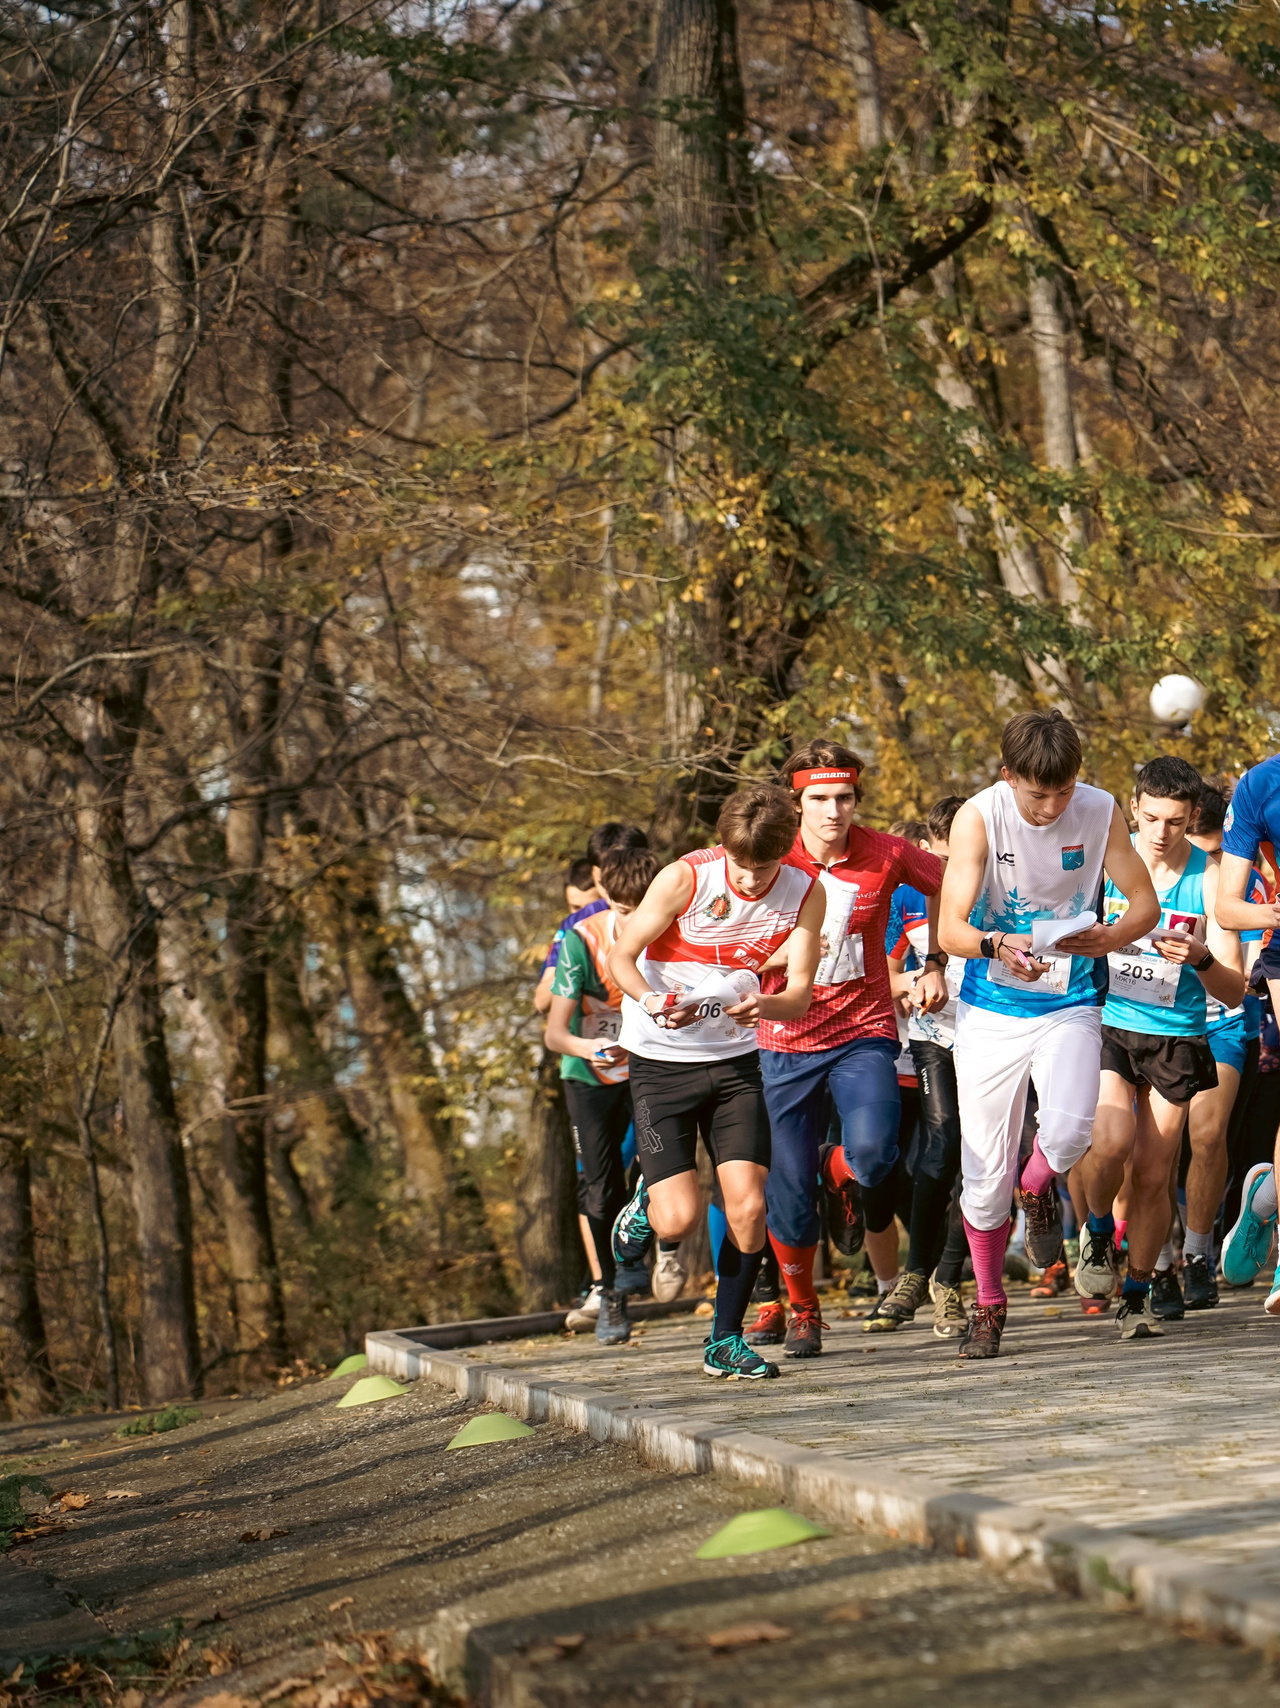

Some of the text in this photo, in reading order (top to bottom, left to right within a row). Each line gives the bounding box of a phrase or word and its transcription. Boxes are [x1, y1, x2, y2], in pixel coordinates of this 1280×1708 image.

[810, 772, 851, 780] noname
[1115, 974, 1136, 985] МЖ16
[1120, 963, 1165, 986] 203 1
[699, 1002, 721, 1019] 06
